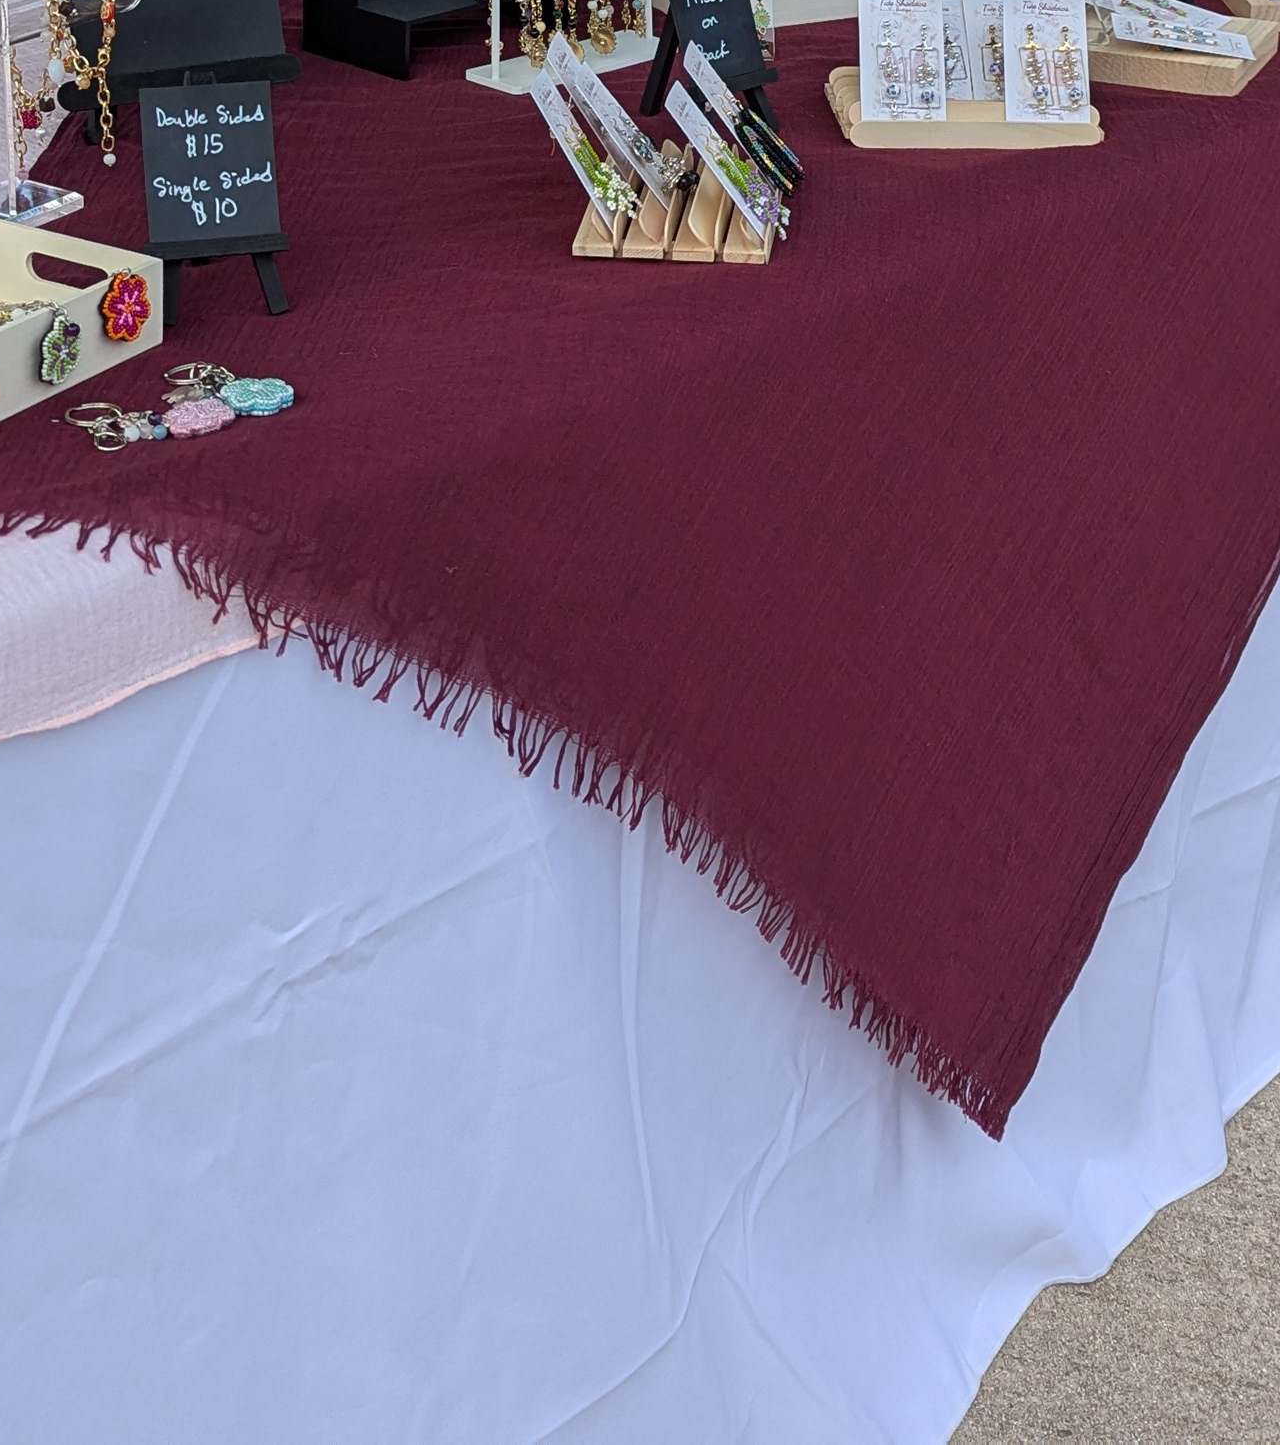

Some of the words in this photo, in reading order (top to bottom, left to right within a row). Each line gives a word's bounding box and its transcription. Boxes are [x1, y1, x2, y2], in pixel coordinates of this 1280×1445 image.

[702, 16, 718, 29] on
[156, 106, 208, 128] Double
[216, 104, 264, 126] Sided
[186, 133, 224, 158] $15
[153, 176, 211, 203] Single
[219, 161, 273, 190] Sided
[191, 197, 238, 226] $10
